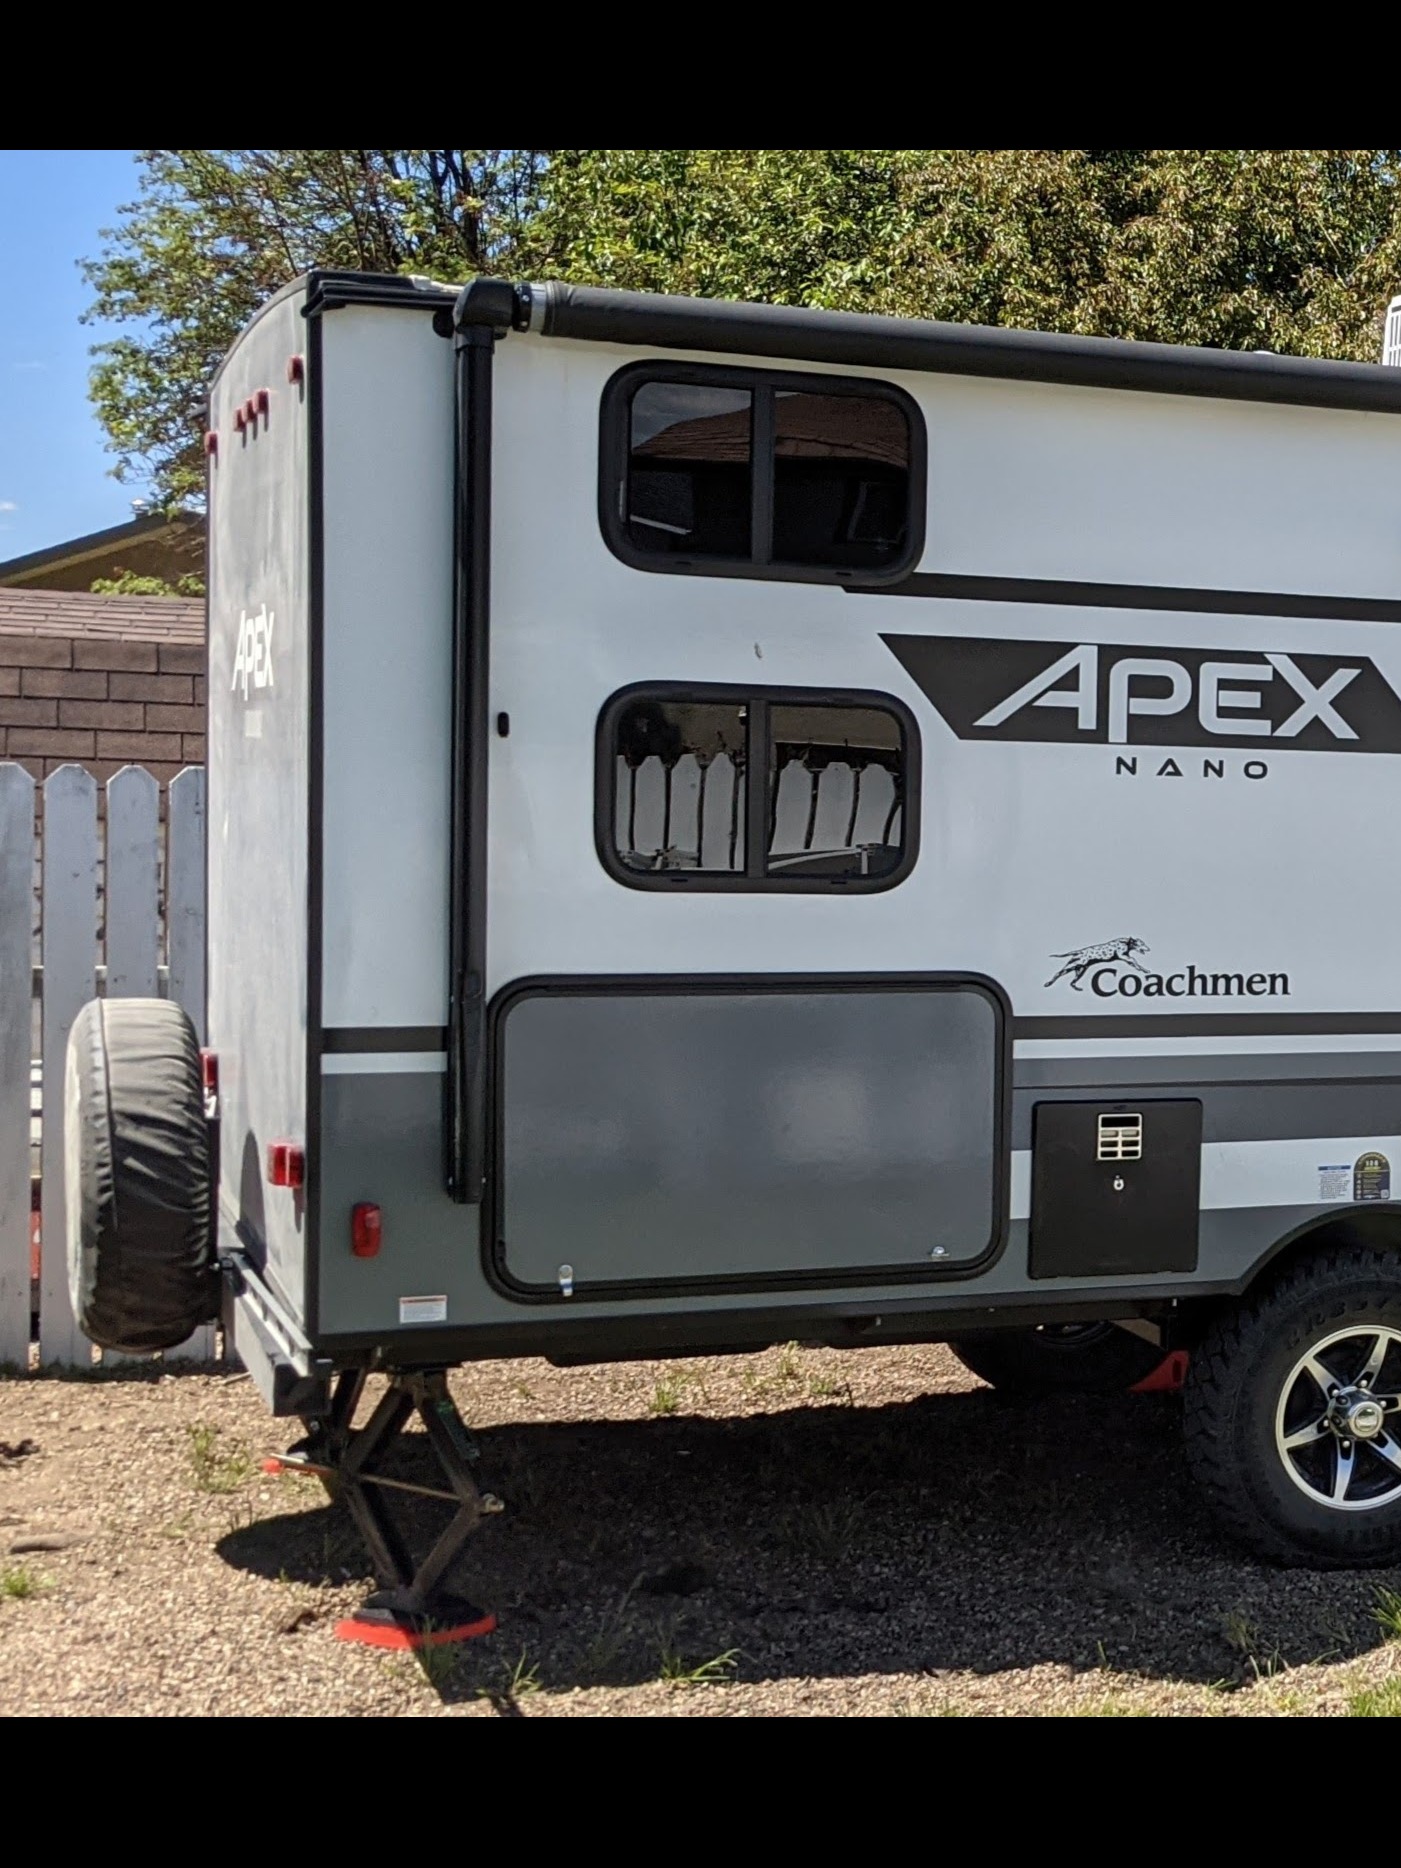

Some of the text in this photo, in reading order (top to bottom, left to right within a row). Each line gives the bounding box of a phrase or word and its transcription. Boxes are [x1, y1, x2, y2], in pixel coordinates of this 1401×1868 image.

[231, 603, 275, 701] APEX
[972, 644, 1363, 744] APEX
[1115, 756, 1269, 780] NANO
[1091, 965, 1291, 997] Coachmen
